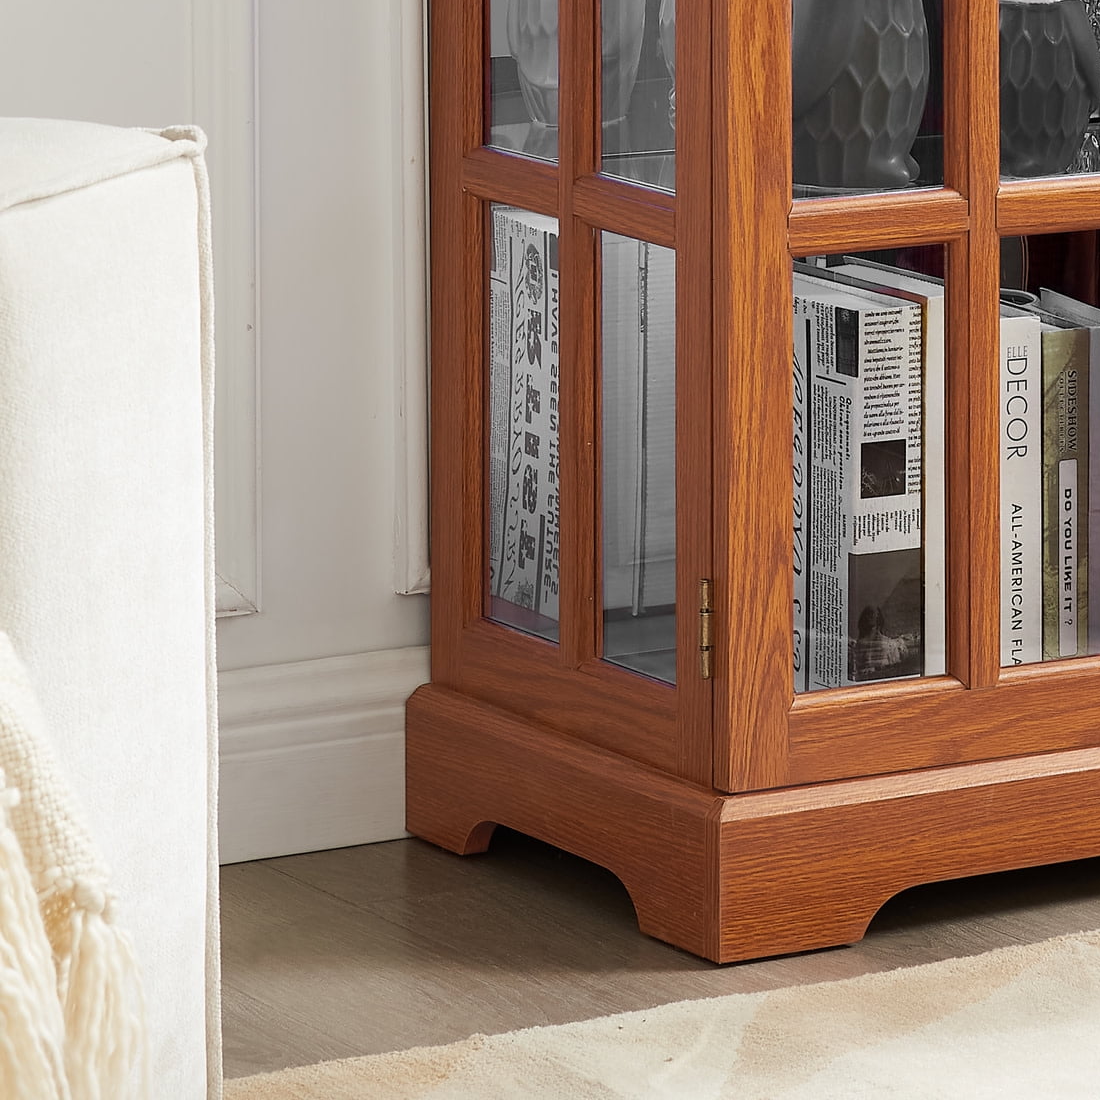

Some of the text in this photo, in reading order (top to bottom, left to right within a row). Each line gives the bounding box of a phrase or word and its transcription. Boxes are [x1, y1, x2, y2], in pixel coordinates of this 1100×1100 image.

[1007, 345, 1028, 358] ELLE
[1006, 357, 1028, 460] DECOR
[1067, 370, 1077, 451] SIDESHOW
[1064, 488, 1072, 512] DO
[1063, 517, 1073, 550] YOU
[1011, 503, 1023, 630] ALL-AMERICAN
[1063, 555, 1073, 592] LIKE
[1063, 597, 1072, 612] IT
